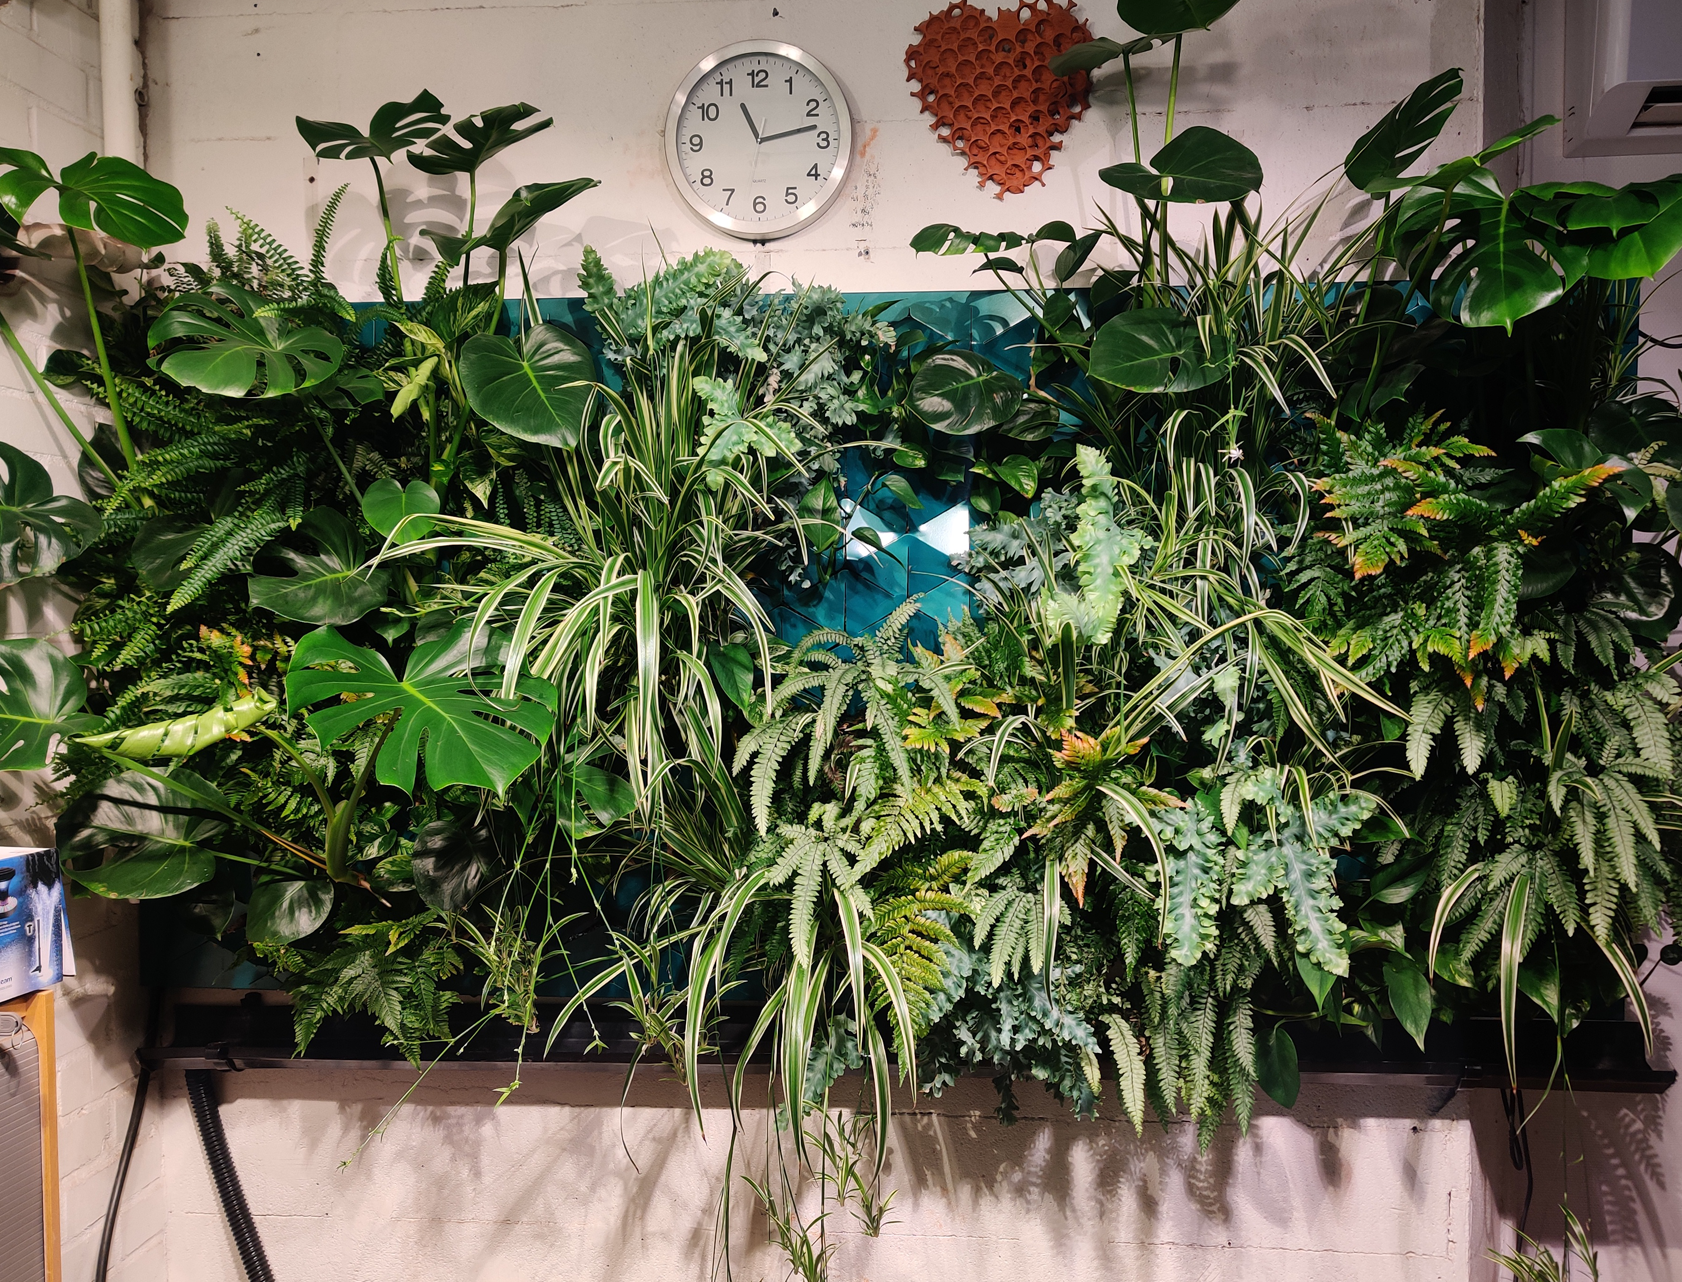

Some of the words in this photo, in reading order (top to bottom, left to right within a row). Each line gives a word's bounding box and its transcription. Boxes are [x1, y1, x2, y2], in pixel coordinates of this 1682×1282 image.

[715, 78, 733, 97] 11
[746, 69, 769, 89] 12
[784, 76, 793, 95] 1
[696, 102, 720, 121] 10
[805, 98, 820, 117] 2
[689, 133, 703, 153] 9
[816, 130, 831, 150] 3
[700, 168, 714, 187] 8
[806, 162, 821, 181] 4
[722, 188, 736, 206] 7
[752, 195, 767, 214] 6
[784, 186, 798, 205] 5
